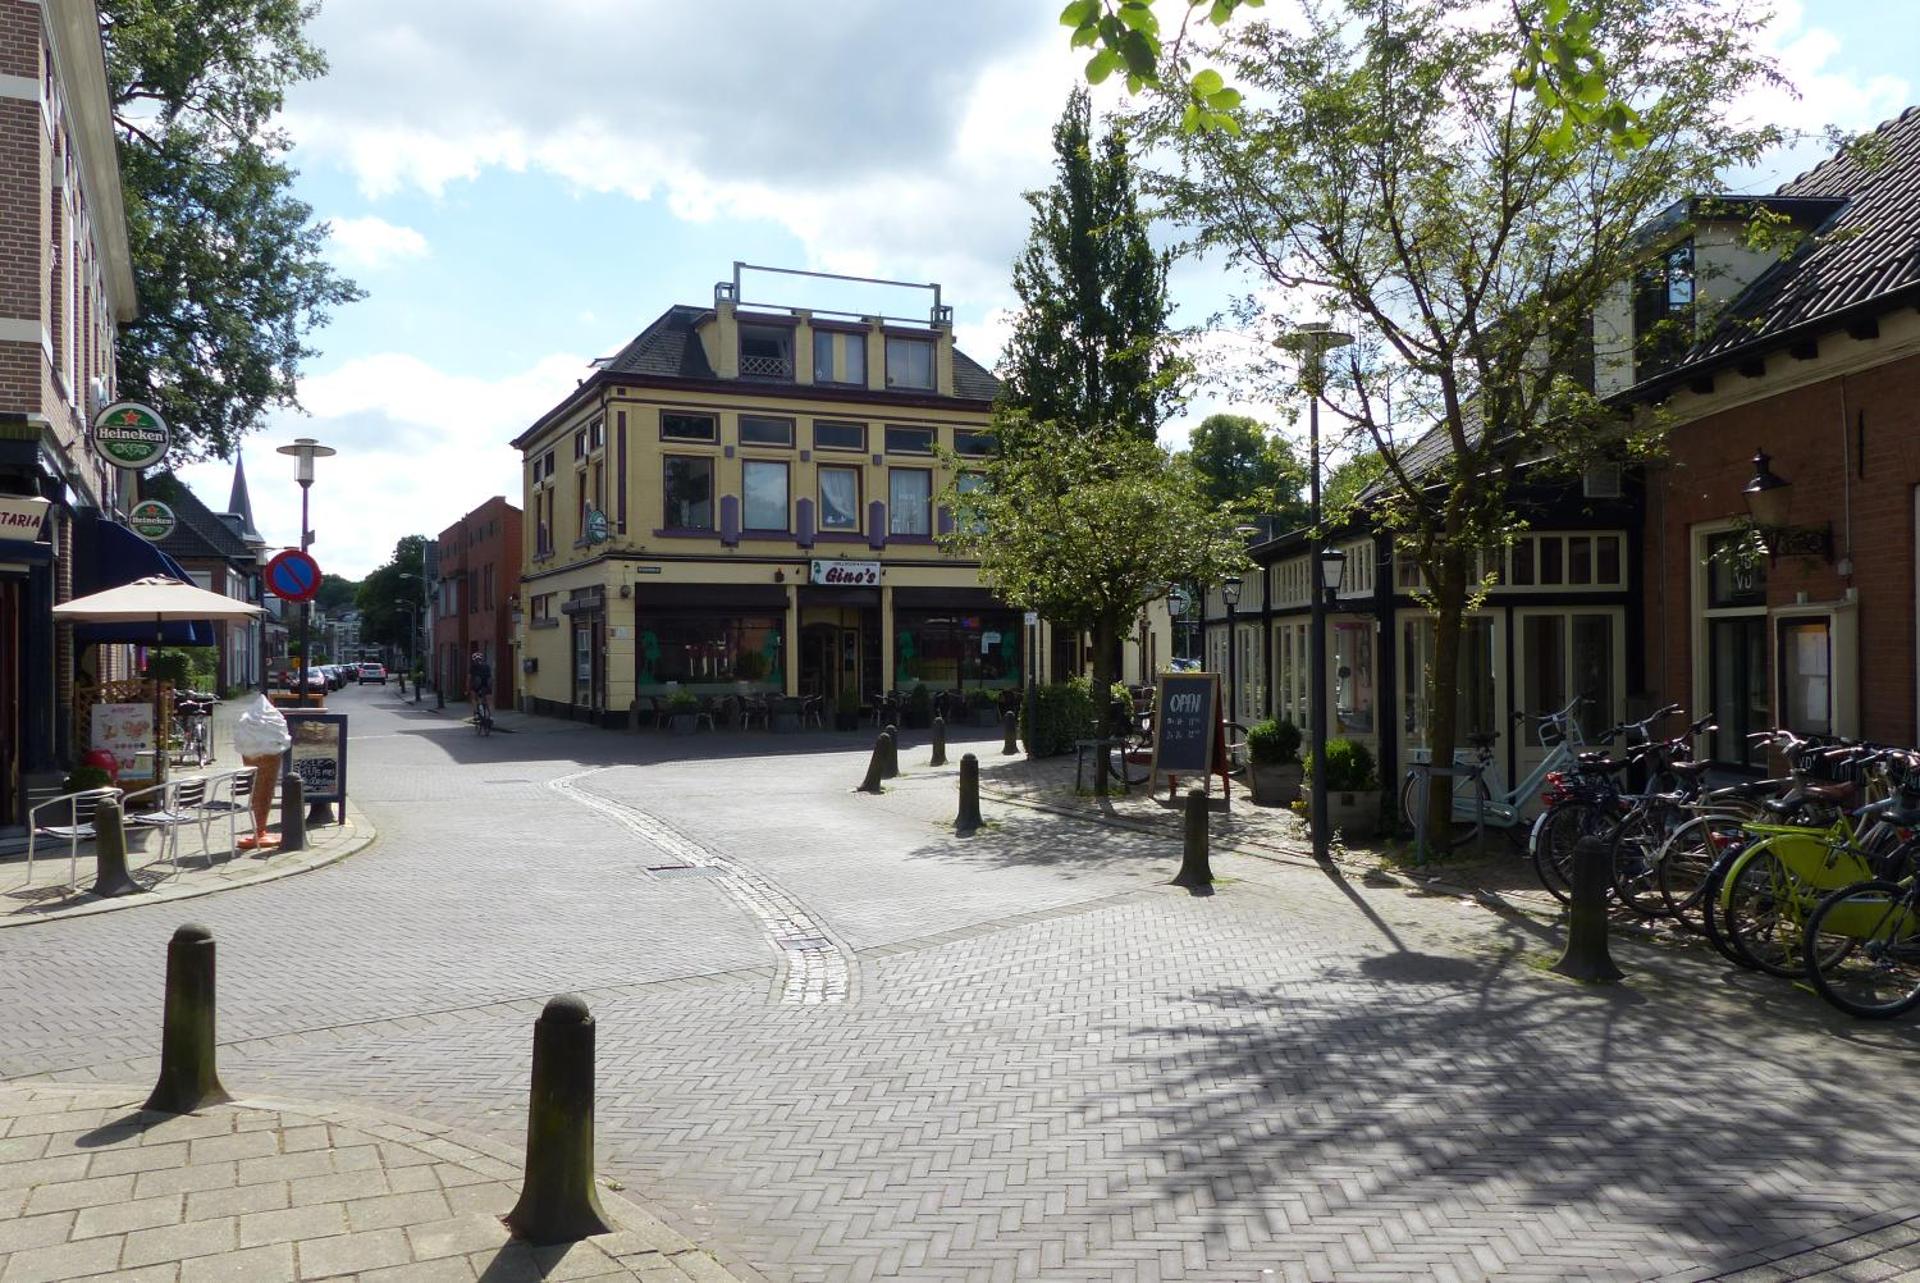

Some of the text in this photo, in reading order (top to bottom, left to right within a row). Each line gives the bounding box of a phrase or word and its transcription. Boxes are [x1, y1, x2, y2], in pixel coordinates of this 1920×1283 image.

[99, 427, 164, 442] Heineken
[0, 511, 41, 528] TARIA
[132, 516, 172, 525] Heineken
[825, 567, 876, 584] Gino's
[1170, 693, 1202, 713] OPEN
